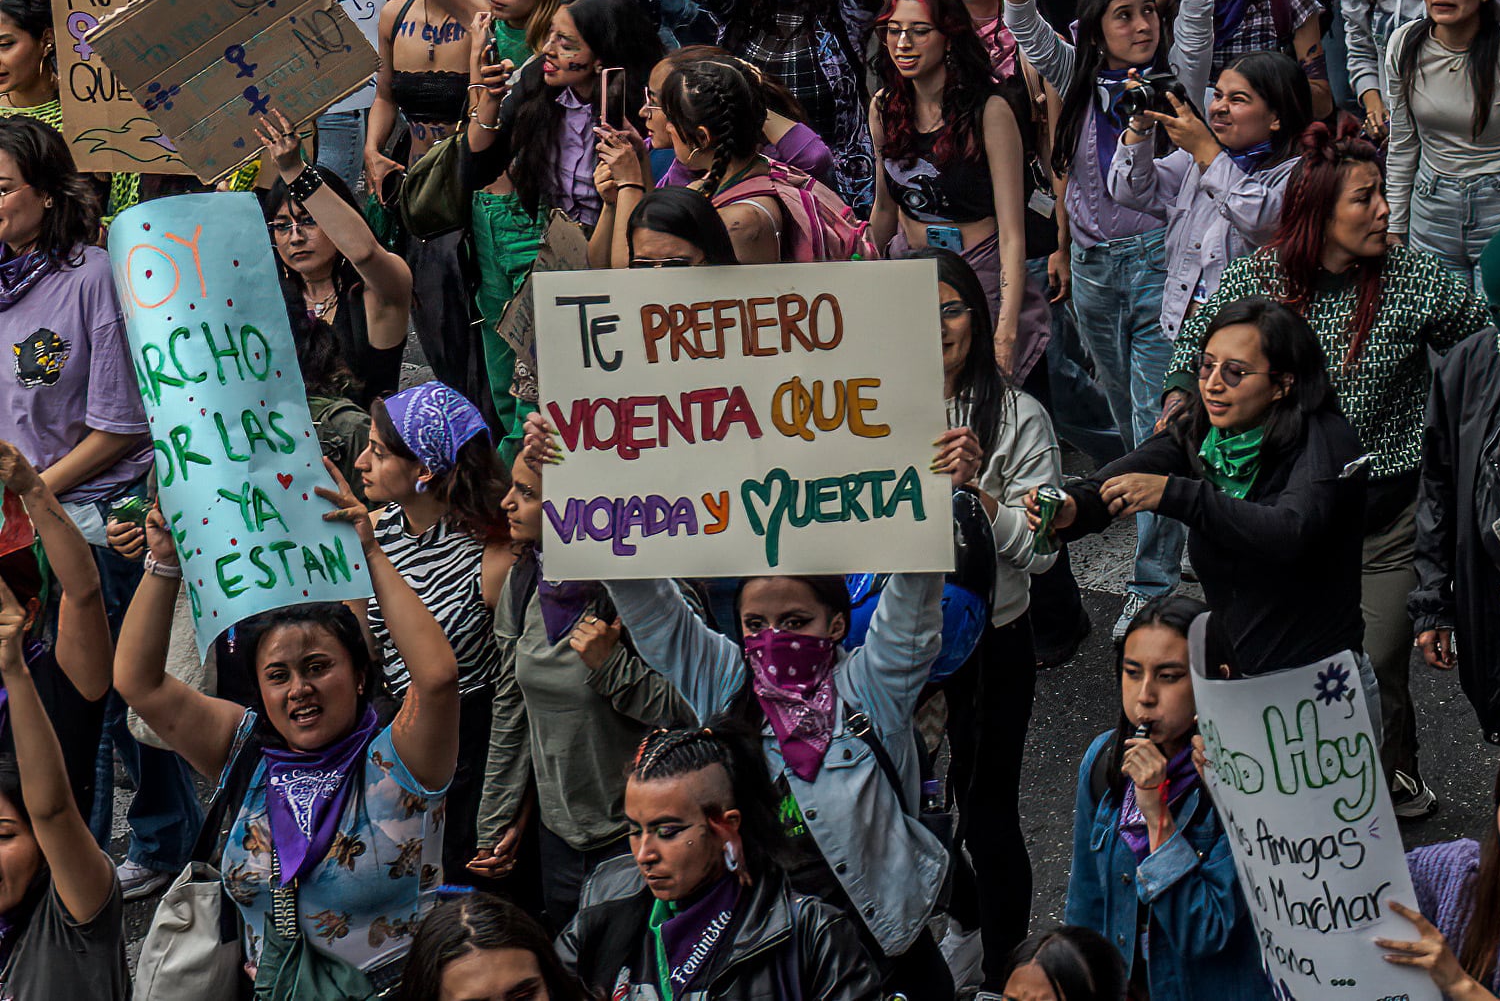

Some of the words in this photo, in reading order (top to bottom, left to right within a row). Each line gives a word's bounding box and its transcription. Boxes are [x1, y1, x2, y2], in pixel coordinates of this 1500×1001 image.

[292, 9, 348, 63] NO
[640, 292, 845, 364] PREFIERO
[213, 408, 296, 463] LAS
[546, 384, 765, 461] VIOLENTA
[770, 374, 892, 442] QUE
[217, 479, 291, 534] YA
[541, 493, 699, 557] VIOLADA
[740, 465, 928, 568] MUERTA
[215, 533, 354, 599] ESTAN
[1262, 698, 1378, 823] Hoy
[1256, 817, 1367, 881] Amigas
[1267, 875, 1392, 934] Marchar
[671, 908, 734, 986] Feminista
